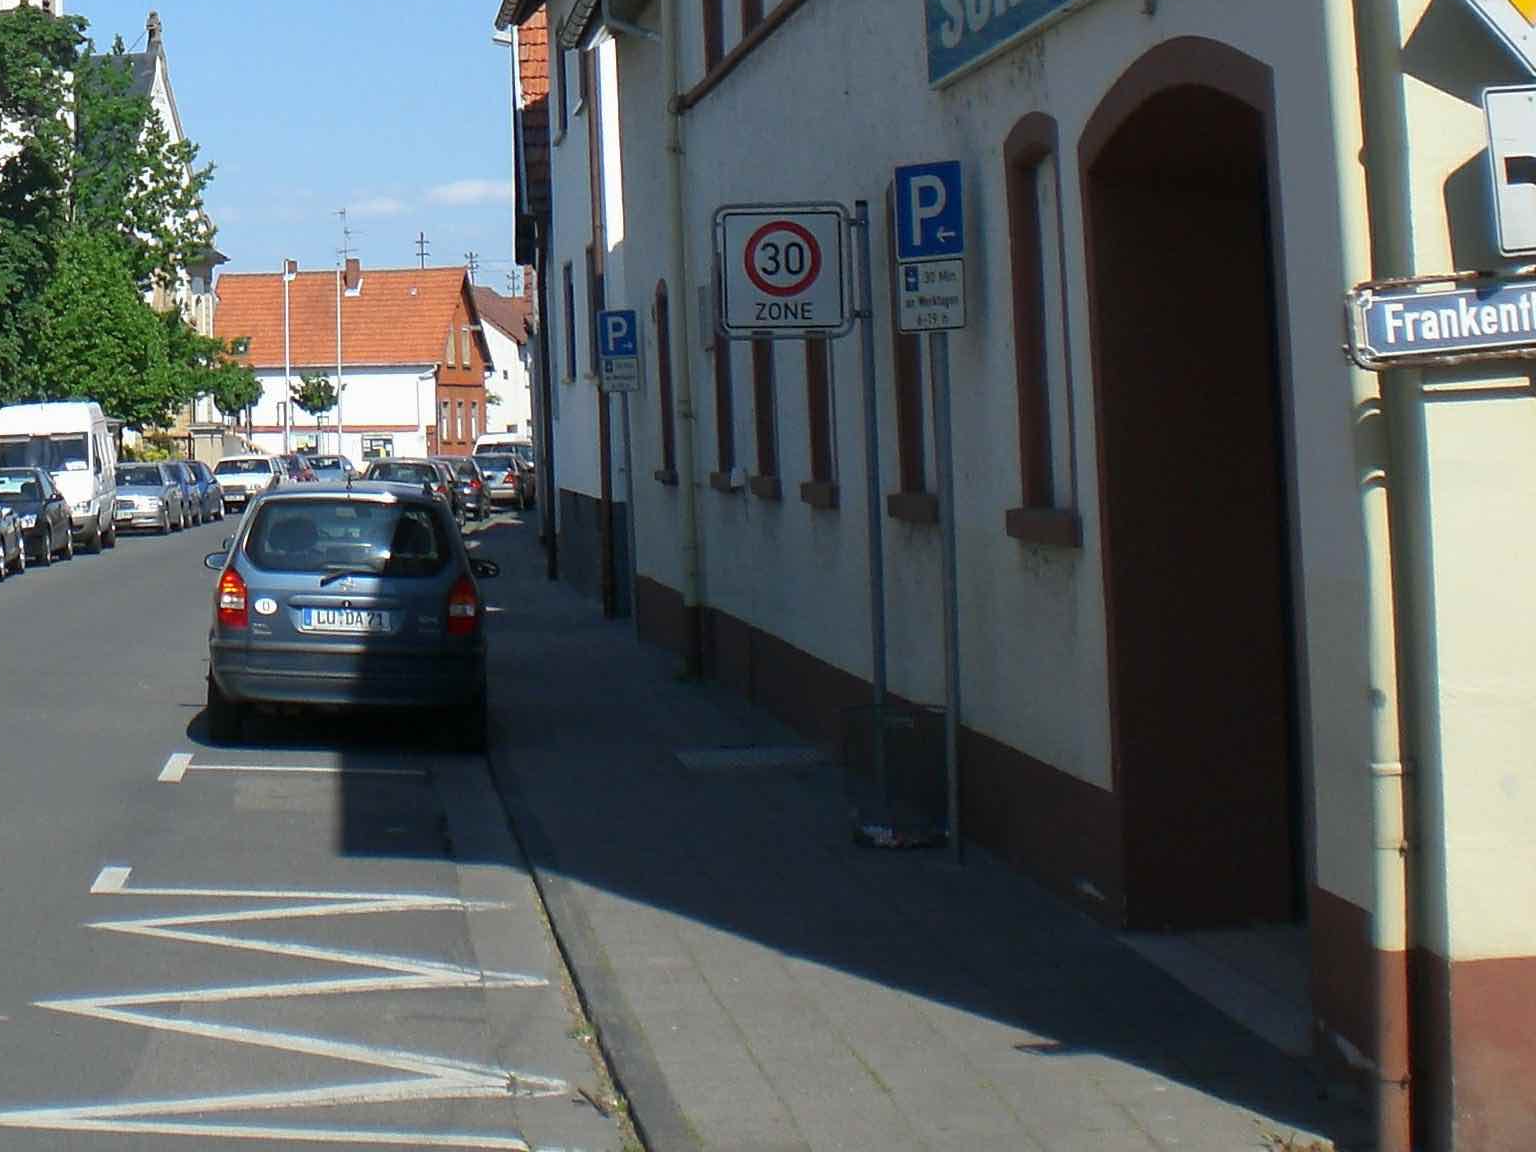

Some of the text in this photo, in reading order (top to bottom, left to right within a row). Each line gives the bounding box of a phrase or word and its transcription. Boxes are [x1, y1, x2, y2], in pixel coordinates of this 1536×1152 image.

[910, 174, 946, 246] P
[760, 241, 805, 275] 30
[755, 301, 814, 321] ZONE
[607, 316, 628, 351] P
